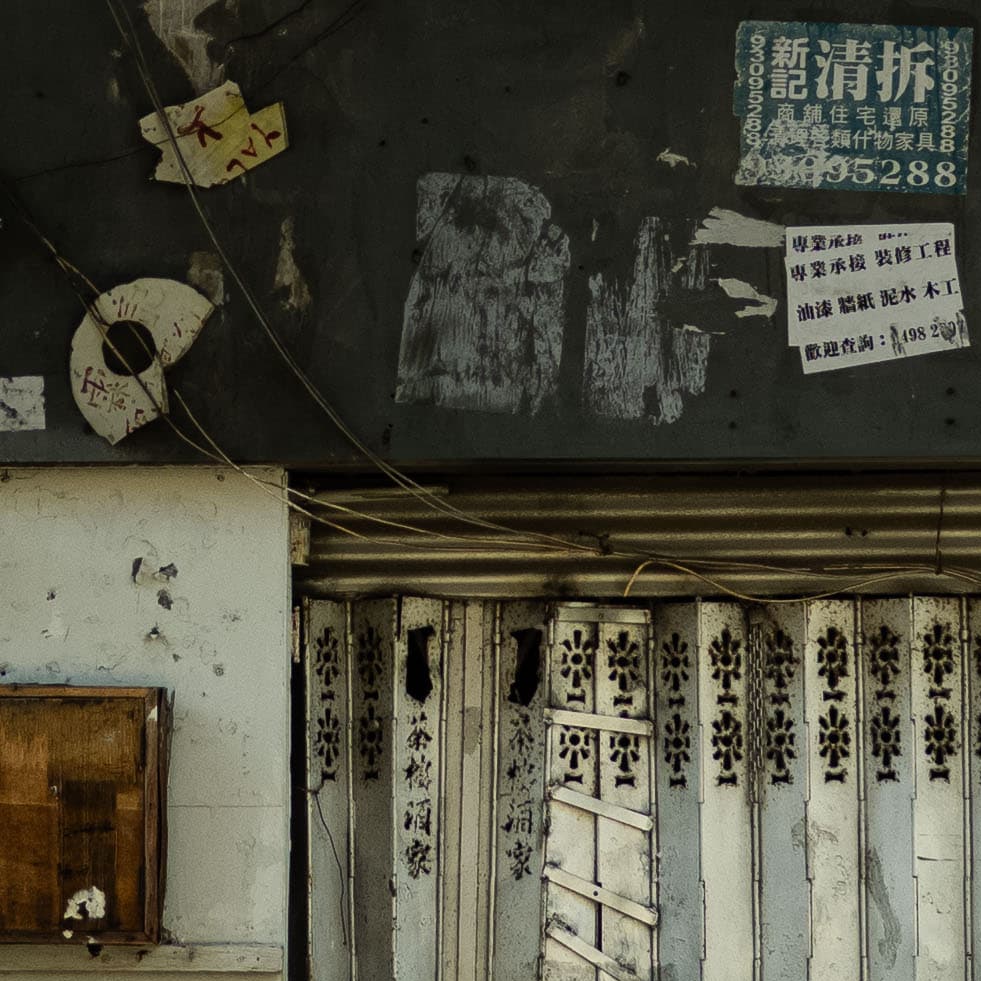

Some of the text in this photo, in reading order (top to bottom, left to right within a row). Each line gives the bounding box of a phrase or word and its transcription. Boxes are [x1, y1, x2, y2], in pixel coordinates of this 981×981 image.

[770, 36, 810, 100] 新記
[815, 39, 935, 103] 清拆
[791, 239, 951, 282] 專業承接 裝修工程
[797, 300, 833, 322] 油漆
[880, 286, 916, 307] 泥水
[923, 278, 959, 299] 木工
